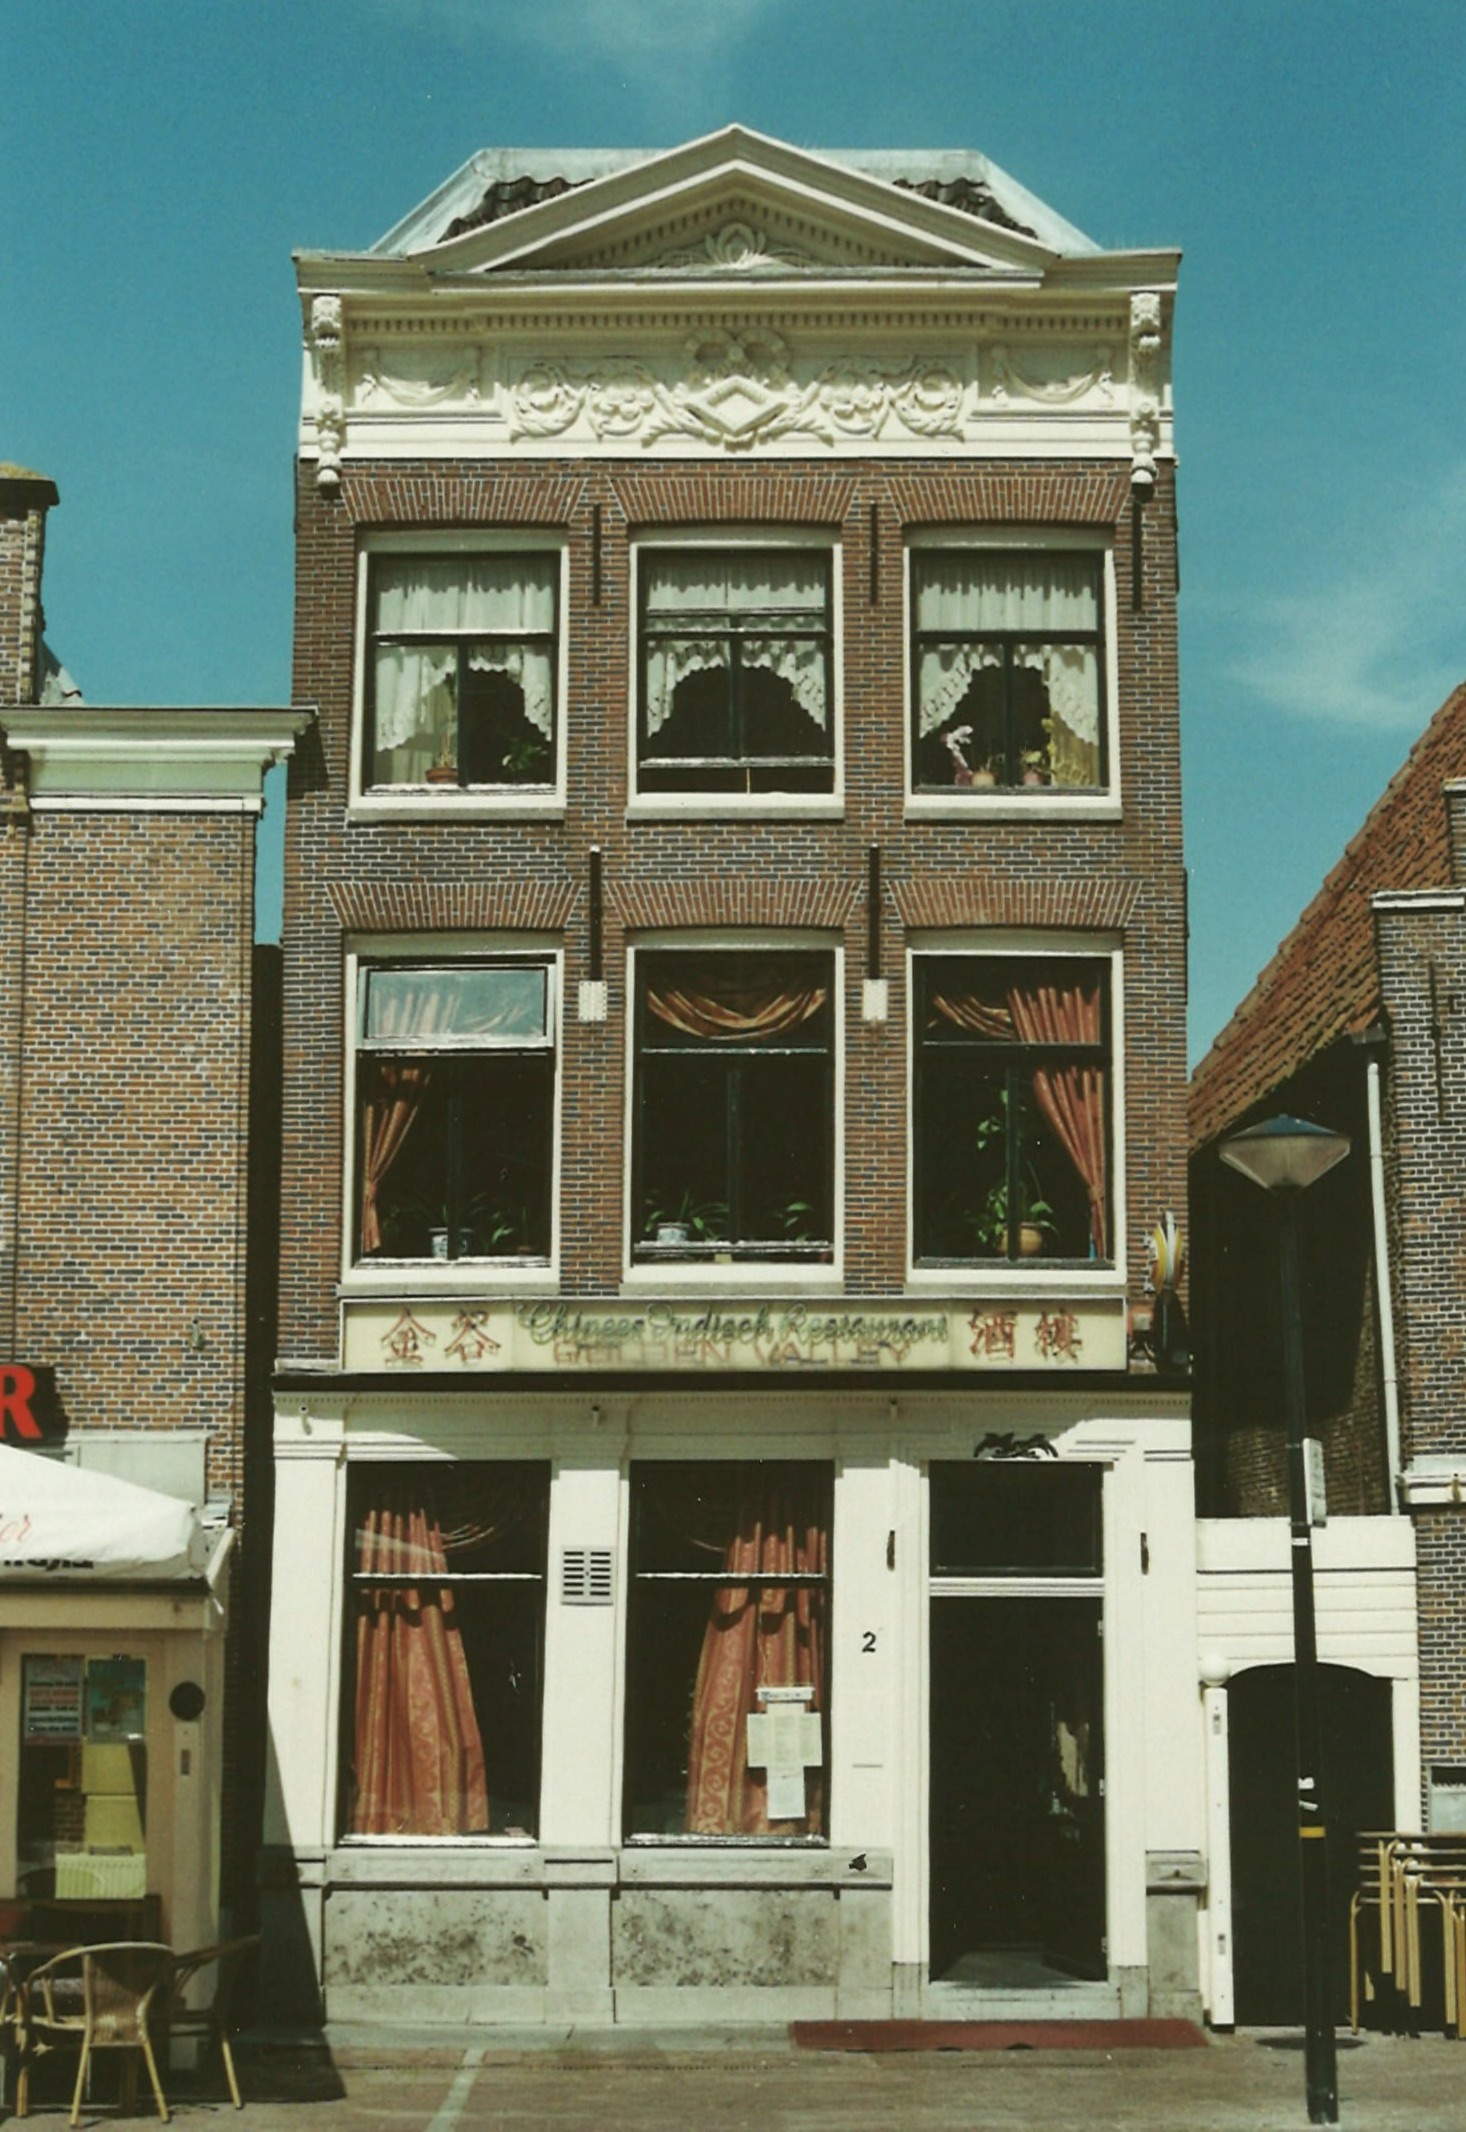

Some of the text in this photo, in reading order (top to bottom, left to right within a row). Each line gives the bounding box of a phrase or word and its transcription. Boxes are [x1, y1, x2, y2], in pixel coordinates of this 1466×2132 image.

[780, 1303, 949, 1345] Restaurant
[553, 1332, 911, 1366] GOLDEN VALLEY
[862, 1631, 876, 1652] 2
